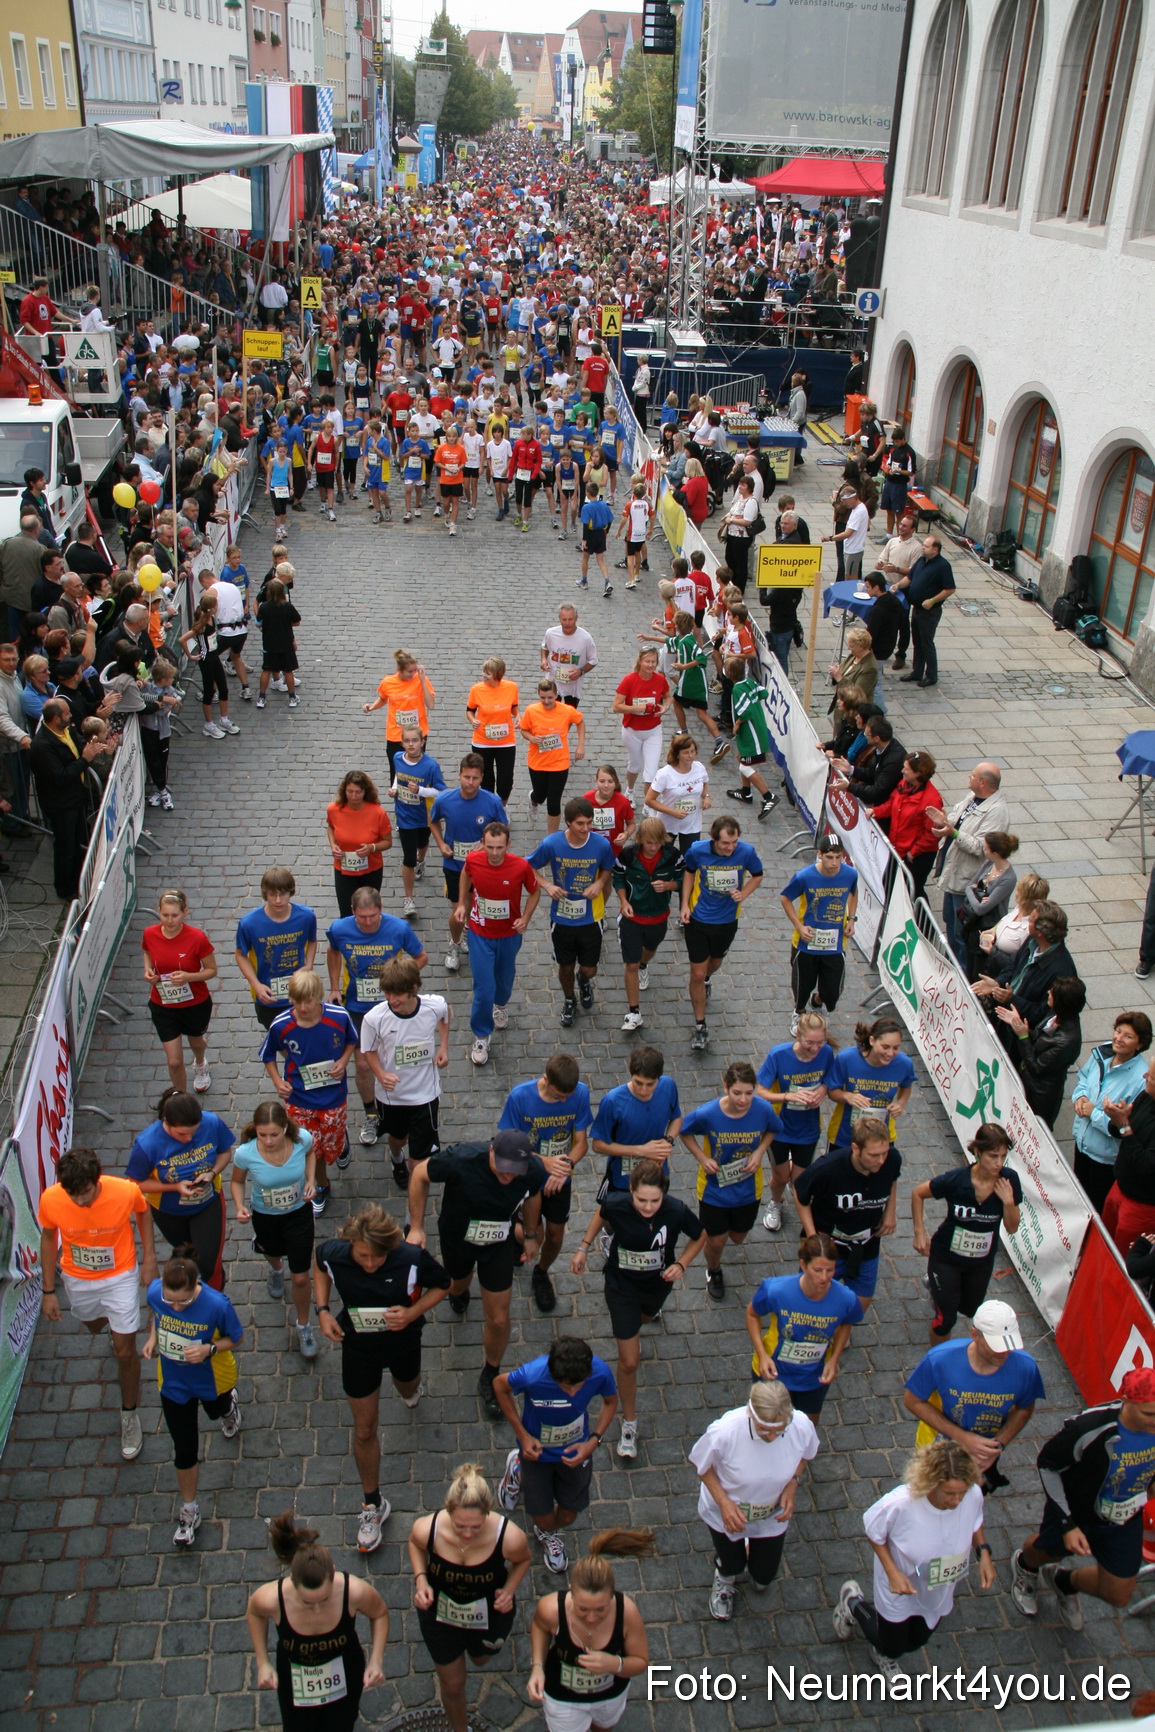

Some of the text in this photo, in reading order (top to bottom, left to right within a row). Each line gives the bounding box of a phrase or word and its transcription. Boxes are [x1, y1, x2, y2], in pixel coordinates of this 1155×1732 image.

[305, 286, 317, 301] A
[606, 314, 618, 330] A
[246, 337, 281, 345] Schnupper-
[762, 557, 817, 567] Schnupper-
[780, 568, 798, 577] lauf
[402, 716, 418, 724] 5162
[492, 730, 508, 738] 5163
[543, 738, 560, 747] 5207
[595, 815, 613, 824] 5080
[347, 858, 366, 866] 5247
[563, 857, 598, 865] NEUMARKTER
[716, 878, 737, 886] 5262
[486, 906, 507, 914] 5251
[565, 906, 585, 914] 5138
[816, 937, 836, 945] 5216
[167, 986, 189, 998] 5075
[405, 1050, 429, 1060] 5030
[312, 1069, 330, 1079] 515
[855, 1084, 891, 1092] STADTLAUF
[857, 1078, 899, 1088] NEUMARKTER
[533, 1120, 568, 1128] STADTLAUF
[1011, 1095, 1042, 1153] Service-Line:
[718, 1131, 761, 1139] NEUMARKTER
[169, 1143, 214, 1164] NEUMARKTER
[170, 1152, 209, 1167] STADTLAUF
[274, 1193, 300, 1206] 5151
[478, 1230, 504, 1240] 5150
[963, 1231, 986, 1240] Barbara
[962, 1241, 988, 1250] 5188
[83, 1254, 111, 1263] 5135
[630, 1257, 657, 1265] 5149
[365, 1317, 387, 1326] 524
[780, 1309, 838, 1324] 10. NEUMARKTER
[161, 1314, 209, 1332] NEUMARKTER
[788, 1317, 829, 1329] STADTLAUF
[158, 1321, 198, 1338] STADTLAUF
[793, 1349, 821, 1358] 5206
[949, 1388, 1015, 1401] 10. NEUMARKTER
[958, 1397, 1005, 1408] STADTLAUF
[553, 1426, 582, 1442] 5252
[431, 1562, 495, 1585] el grano
[943, 1559, 968, 1578] 5226
[450, 1610, 484, 1622] 5196
[282, 1634, 348, 1655] el grano
[303, 1667, 324, 1678] Nadja
[306, 1674, 342, 1693] 5198
[576, 1674, 608, 1688] 5197
